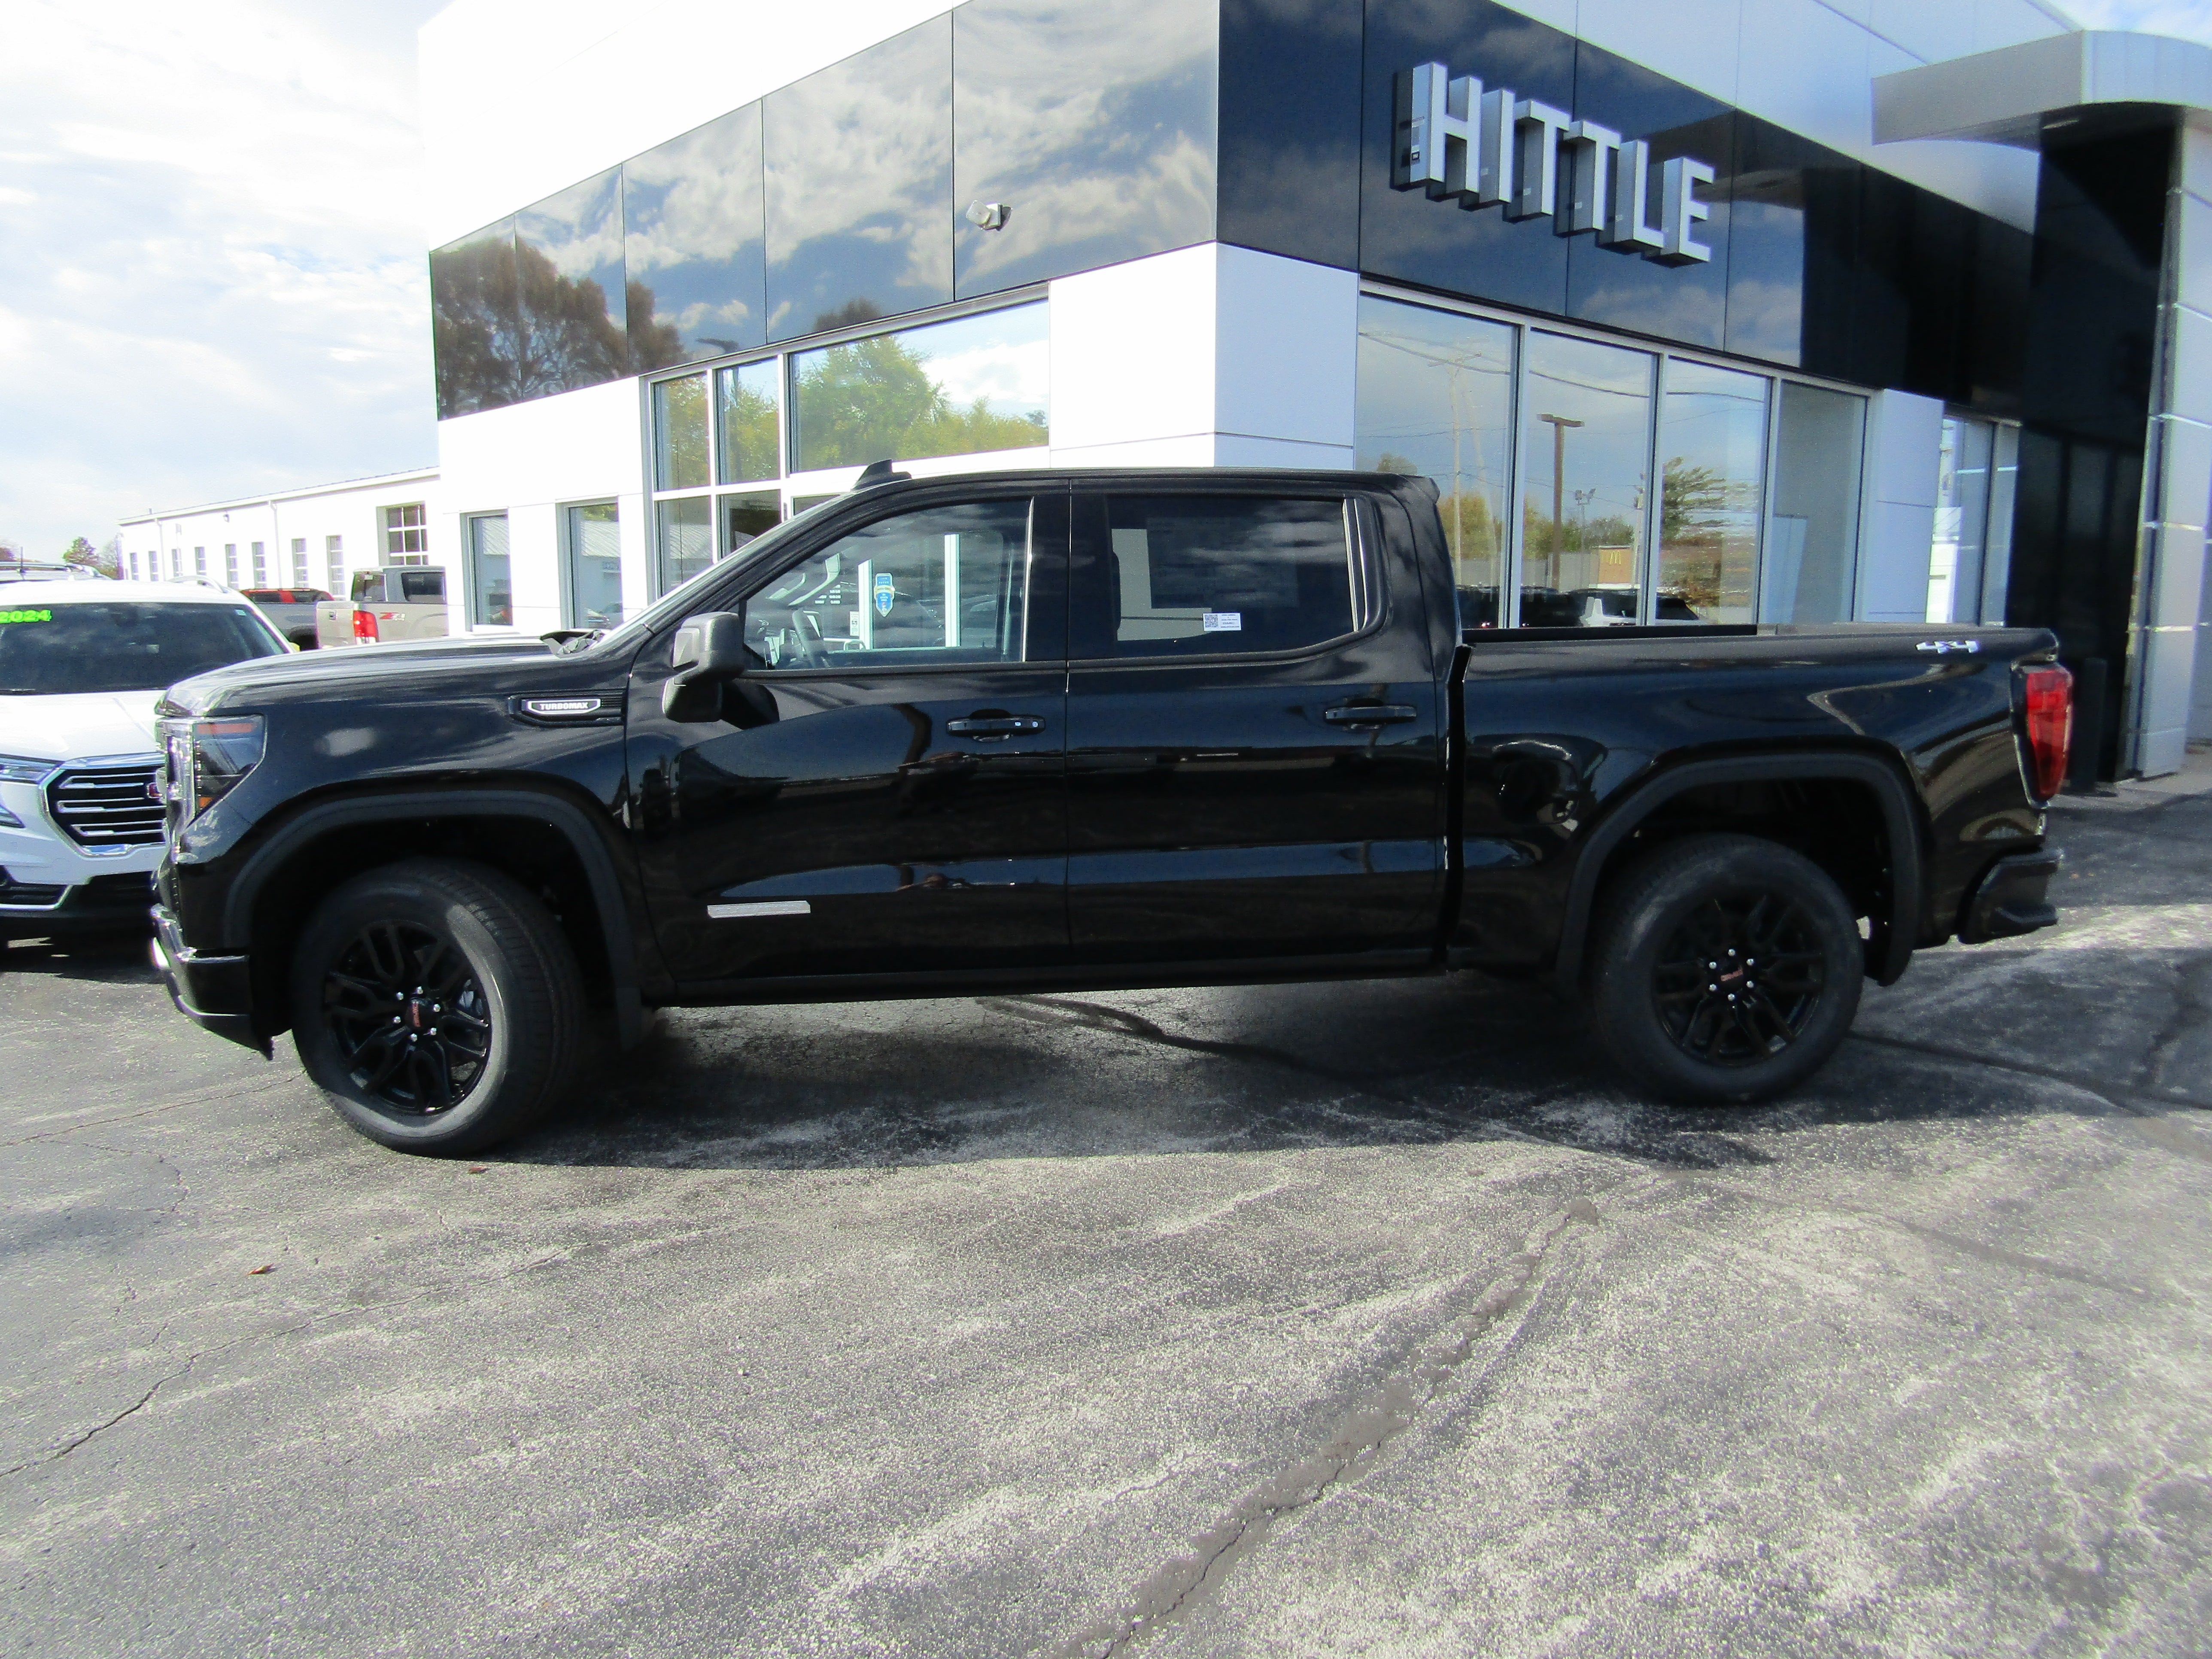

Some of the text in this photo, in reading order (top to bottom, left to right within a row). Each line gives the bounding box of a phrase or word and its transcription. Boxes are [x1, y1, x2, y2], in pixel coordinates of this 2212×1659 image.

[1411, 61, 1714, 262] HITTLE
[0, 610, 52, 623] 2024
[540, 702, 589, 710] TURBOMAX
